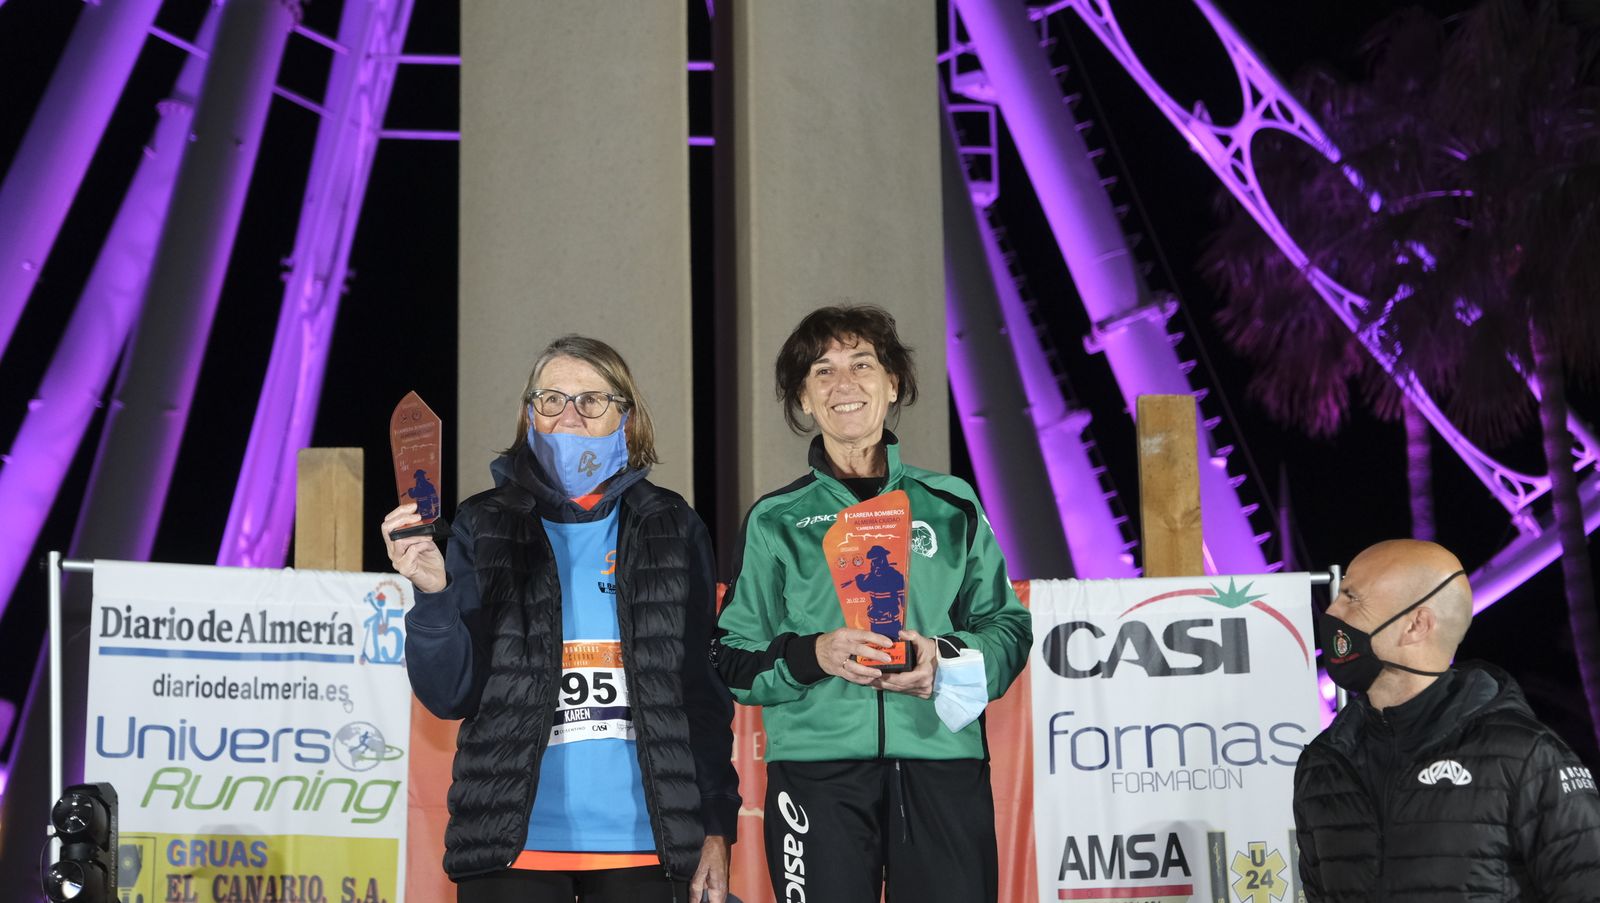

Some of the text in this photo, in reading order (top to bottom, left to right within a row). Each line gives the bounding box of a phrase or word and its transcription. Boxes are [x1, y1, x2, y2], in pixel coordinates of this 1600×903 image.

[848, 509, 904, 519] CARRERA BOMBEROS
[99, 605, 354, 646] Diario de Almería
[1042, 617, 1250, 679] CASI
[153, 674, 350, 702] diariodealmeria.es
[564, 708, 591, 722] KAREN
[1049, 711, 1306, 775] formas
[1112, 765, 1243, 793] FORMACIÓN
[140, 767, 402, 824] Running
[166, 839, 268, 868] GRUAS
[1058, 832, 1192, 881] AMSA
[1251, 849, 1265, 867] U
[166, 874, 198, 903] EL
[1246, 869, 1274, 889] 24
